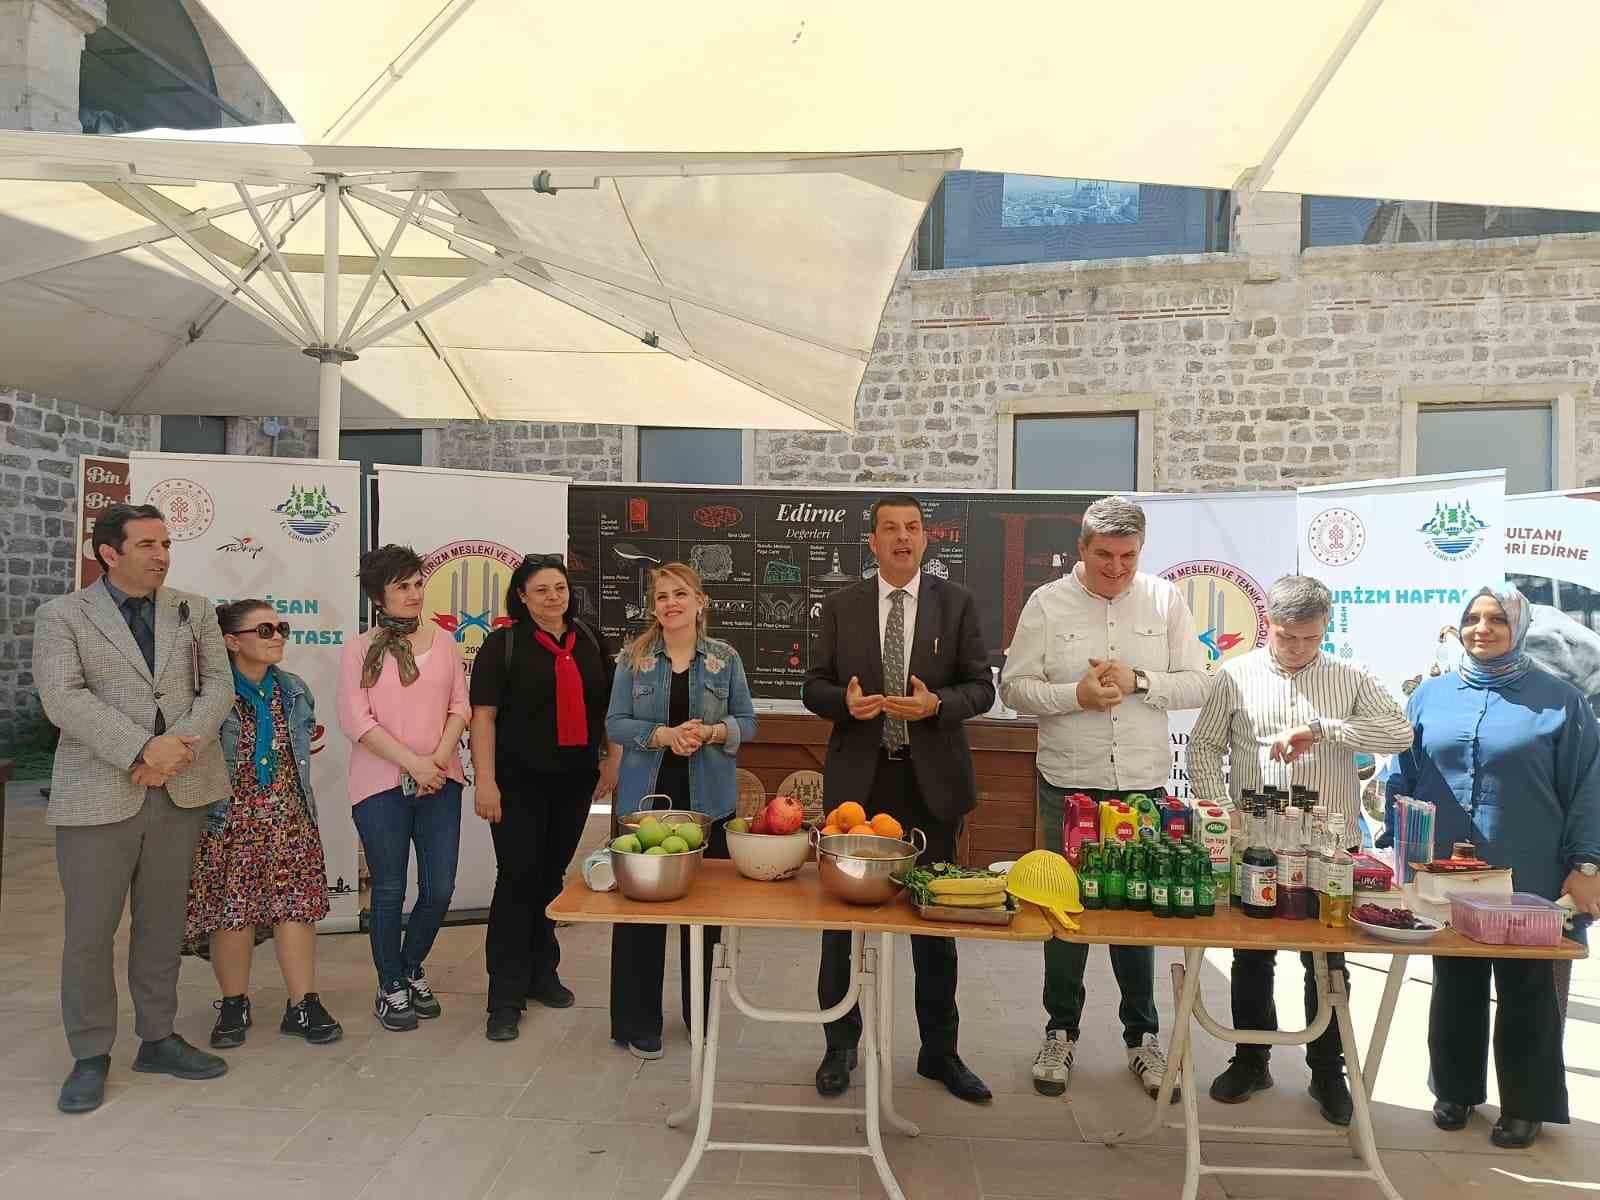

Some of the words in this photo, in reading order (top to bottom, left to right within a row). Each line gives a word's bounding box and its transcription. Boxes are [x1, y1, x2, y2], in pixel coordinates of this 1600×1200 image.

[86, 466, 123, 485] Bin
[85, 492, 118, 510] Bi
[776, 503, 846, 523] Edirne
[786, 528, 831, 540] Değerleri
[1505, 527, 1562, 542] ULTANI
[496, 550, 507, 561] VE
[1504, 541, 1526, 555] HRİ
[1531, 542, 1589, 561] EDİRNE
[1222, 568, 1234, 580] VE
[1331, 586, 1391, 604] URİZM
[1395, 589, 1467, 604] HAFTA
[291, 630, 344, 645] TASI
